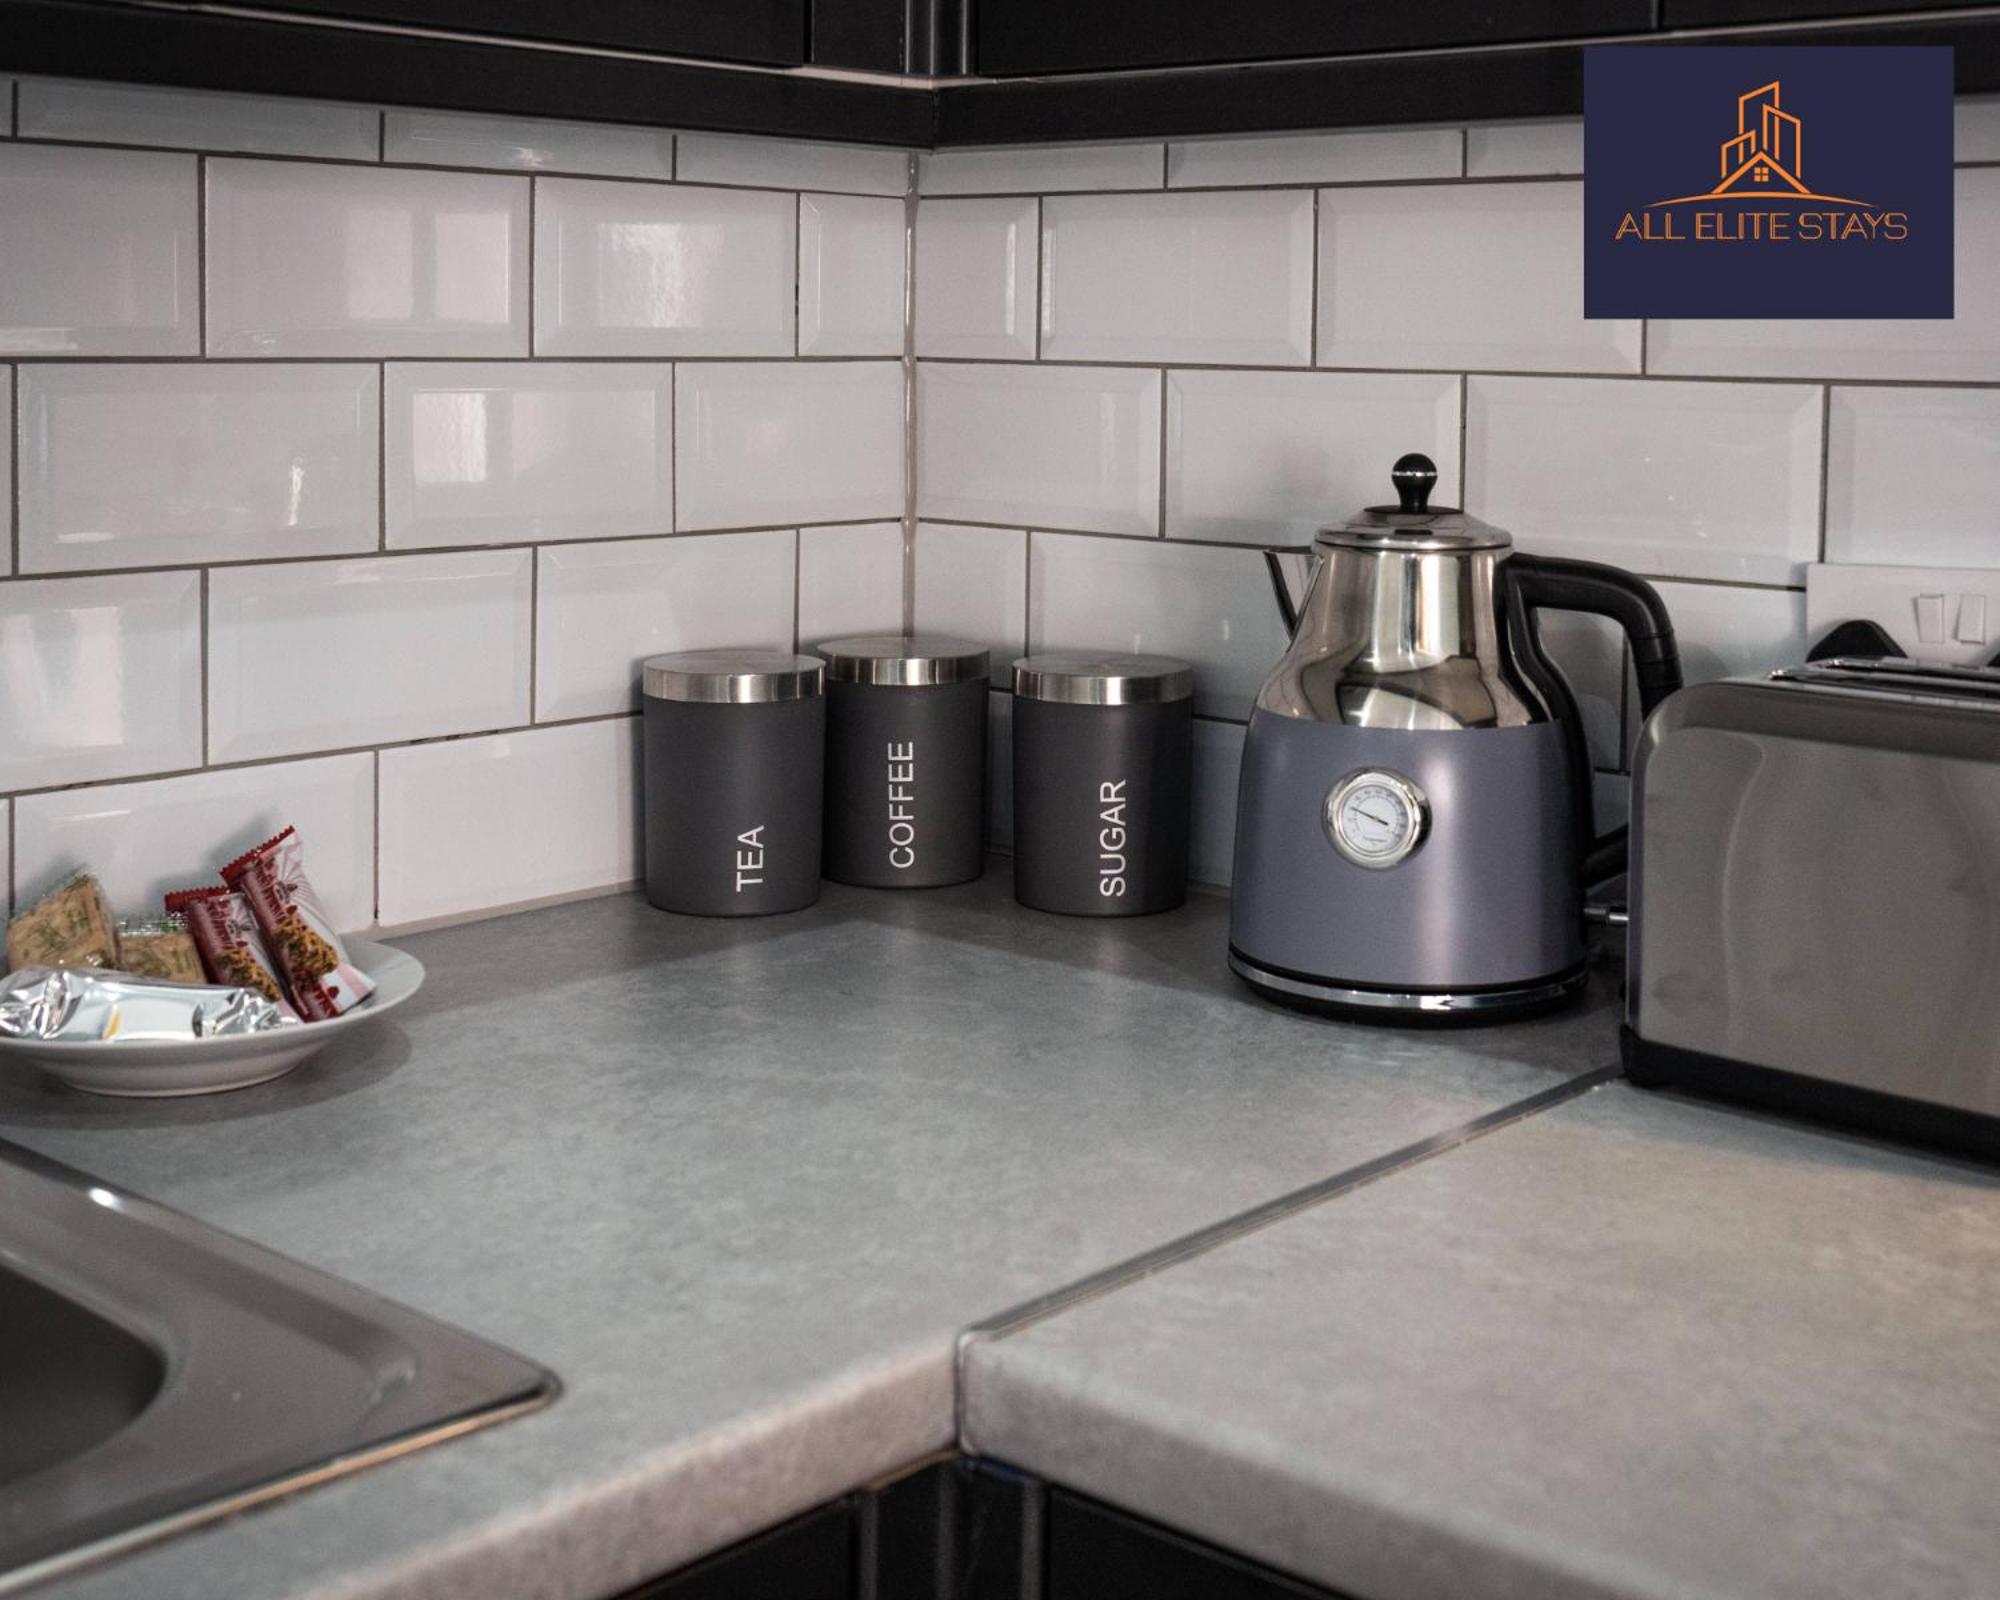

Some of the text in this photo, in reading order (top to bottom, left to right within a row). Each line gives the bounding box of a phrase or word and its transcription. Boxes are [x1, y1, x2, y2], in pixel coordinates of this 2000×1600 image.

[735, 824, 765, 892] TEA
[887, 741, 915, 868] COFFEE
[1099, 780, 1126, 897] SUGAR
